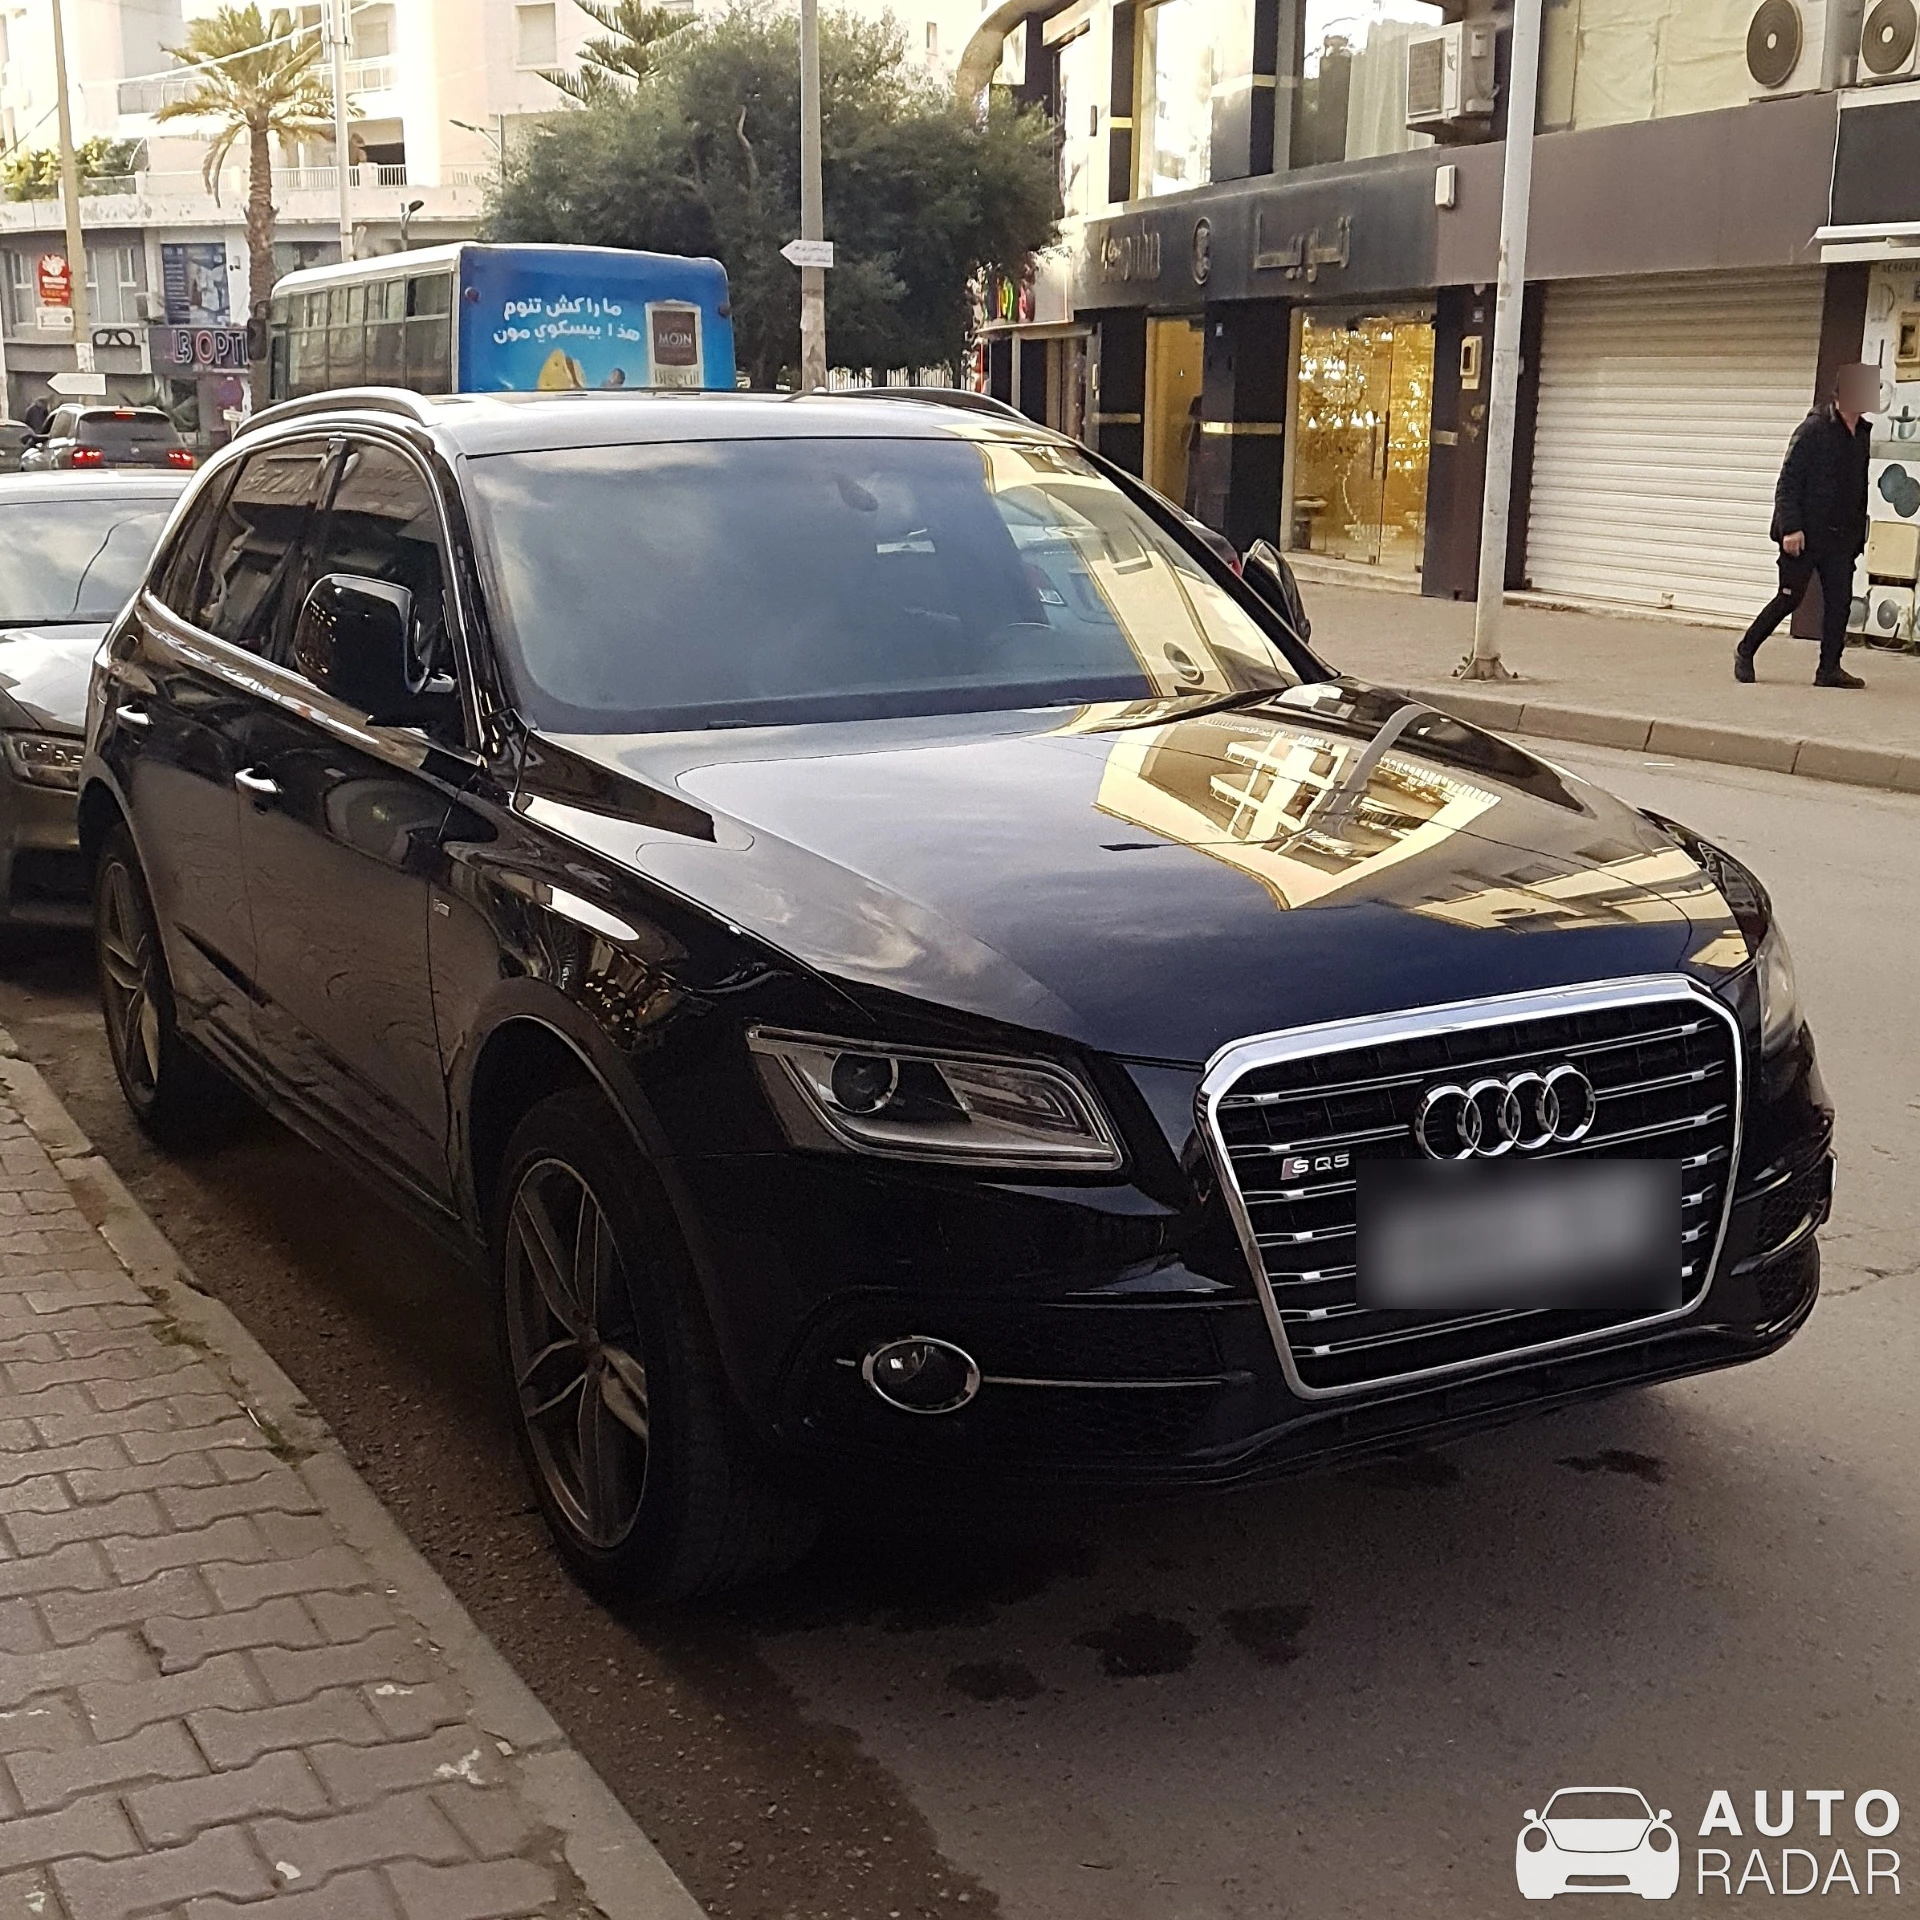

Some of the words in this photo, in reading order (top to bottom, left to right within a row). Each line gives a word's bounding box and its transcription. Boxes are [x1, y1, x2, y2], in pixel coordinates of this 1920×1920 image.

[504, 297, 542, 320] تنوم
[493, 326, 531, 344] مون
[534, 319, 601, 343] بيسكوي
[608, 322, 641, 341] هذا
